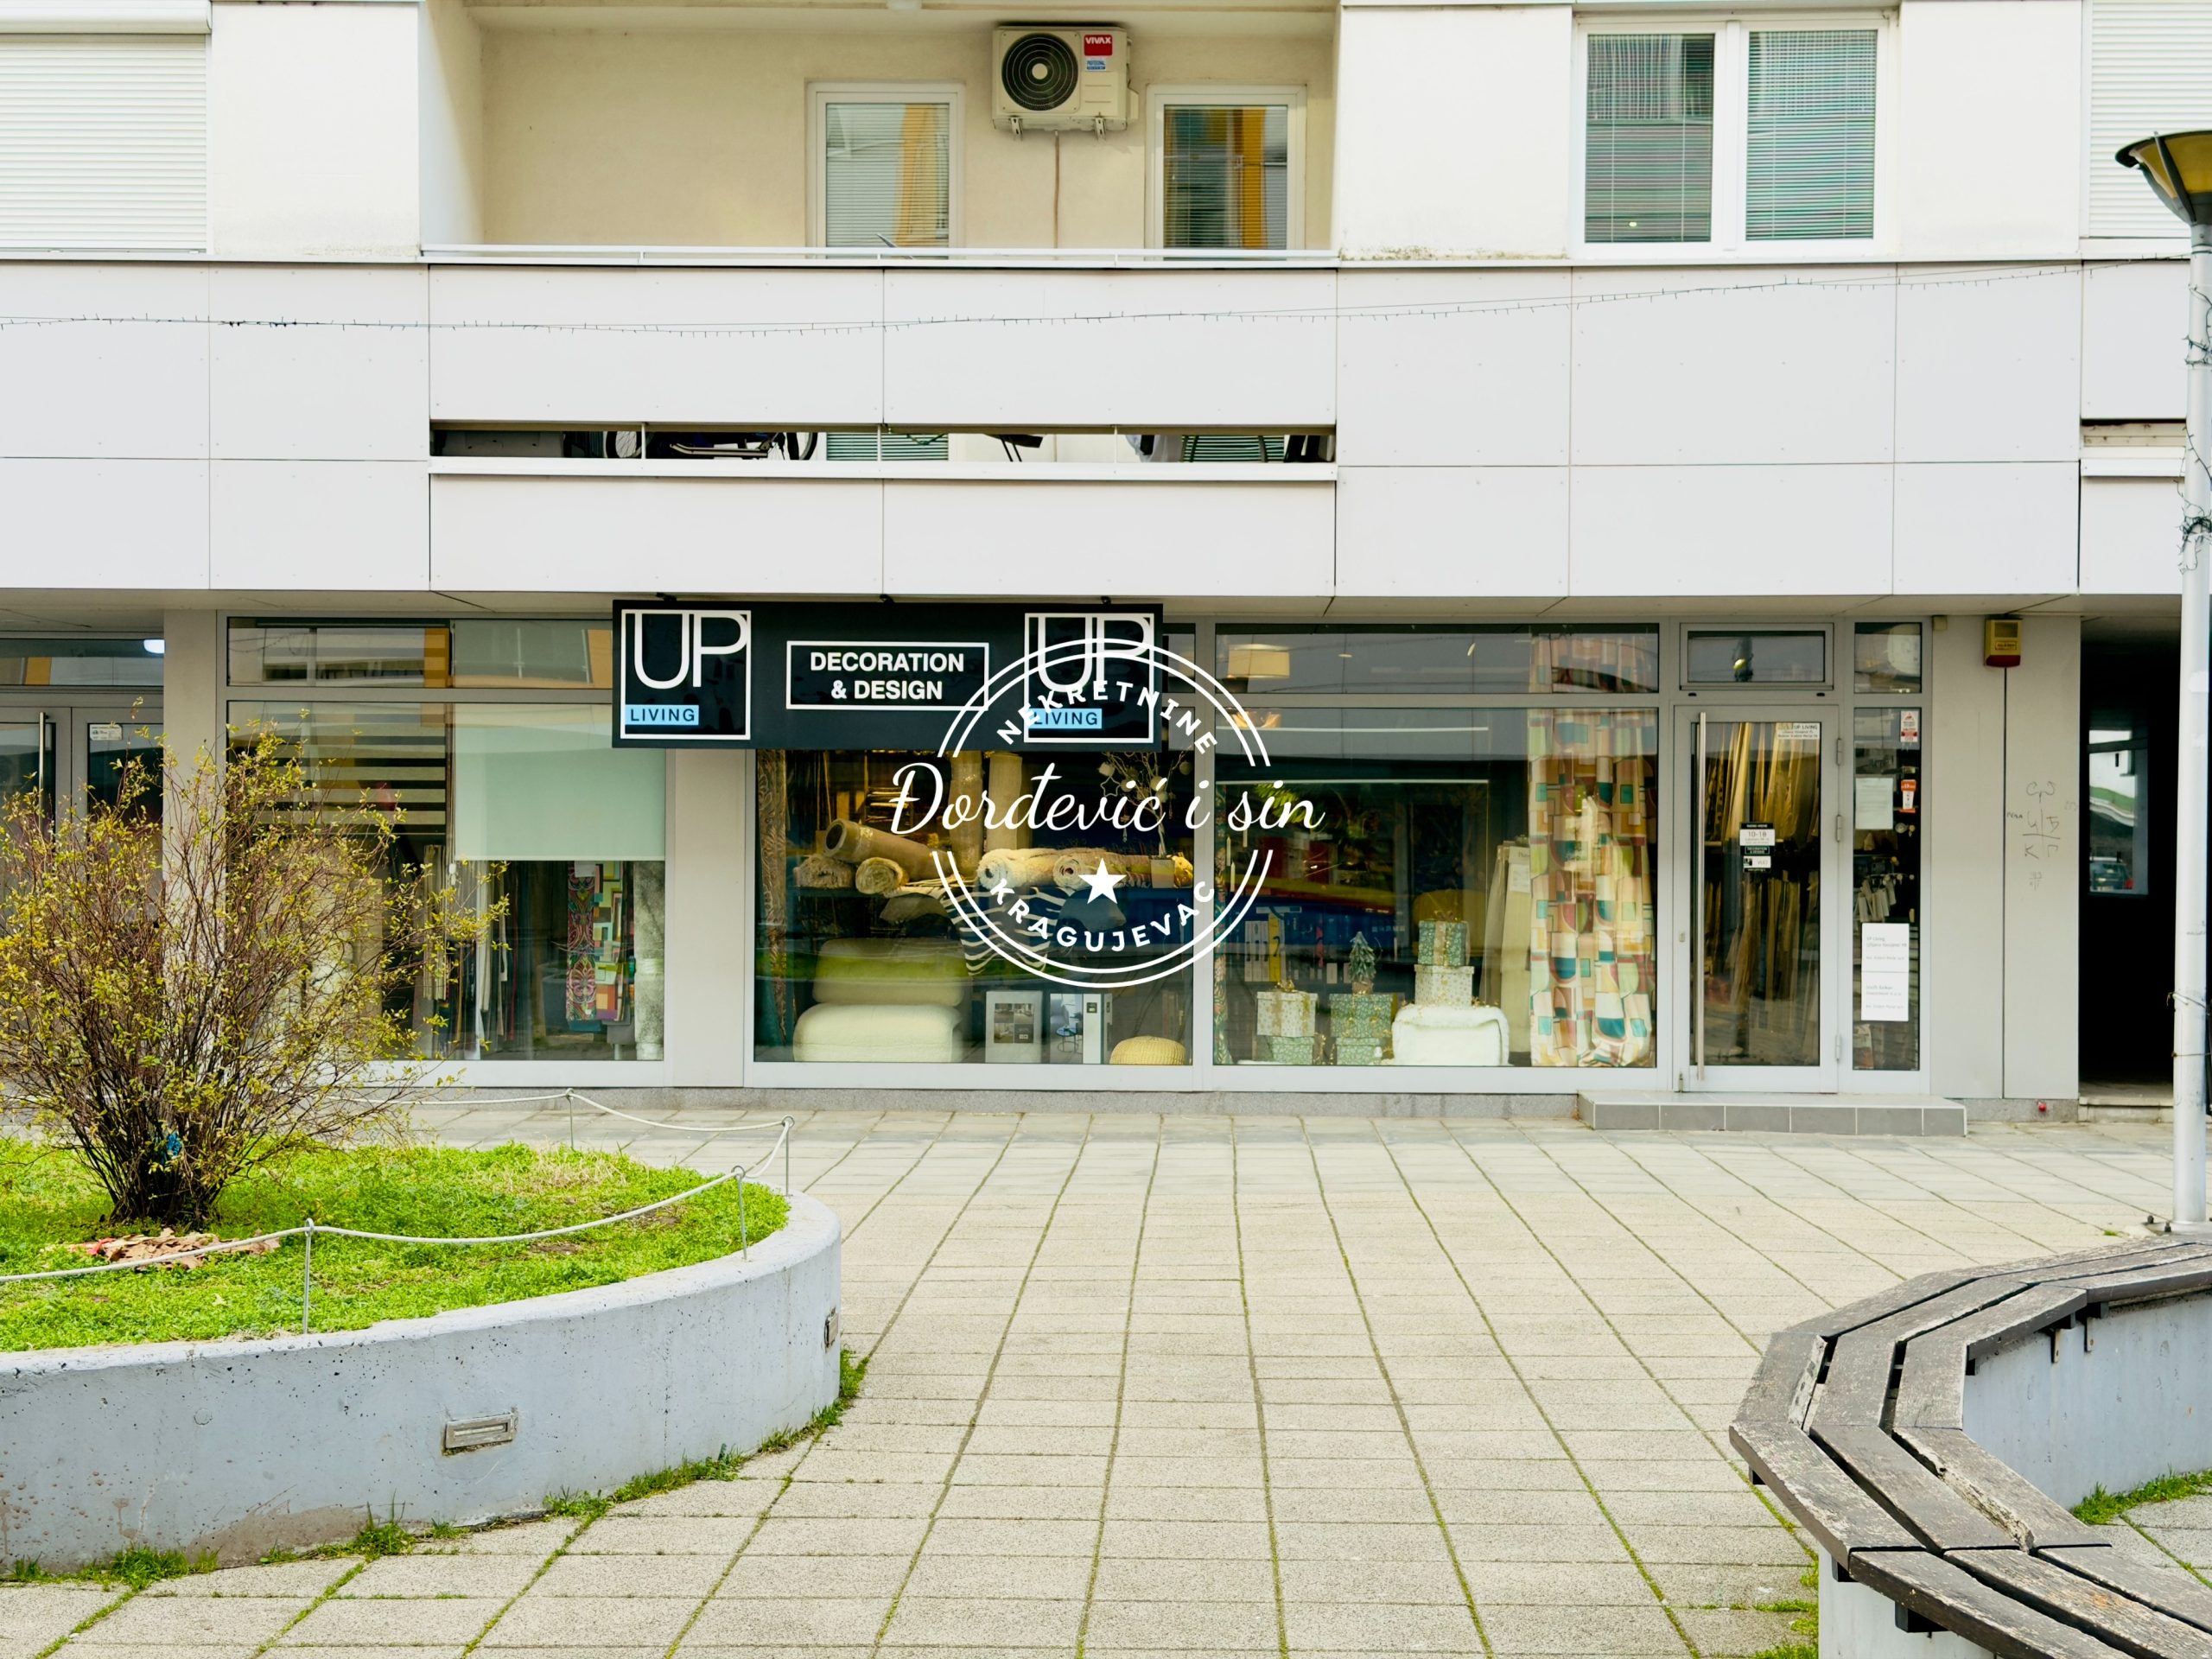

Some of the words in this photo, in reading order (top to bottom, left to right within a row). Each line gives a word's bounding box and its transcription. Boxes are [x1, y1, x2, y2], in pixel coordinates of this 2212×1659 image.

[634, 611, 747, 690] UP
[1038, 613, 1151, 692] UP
[810, 652, 964, 672] DECORATION
[831, 680, 847, 699] &
[854, 680, 943, 700] DESIGN
[630, 709, 695, 721] LIVING
